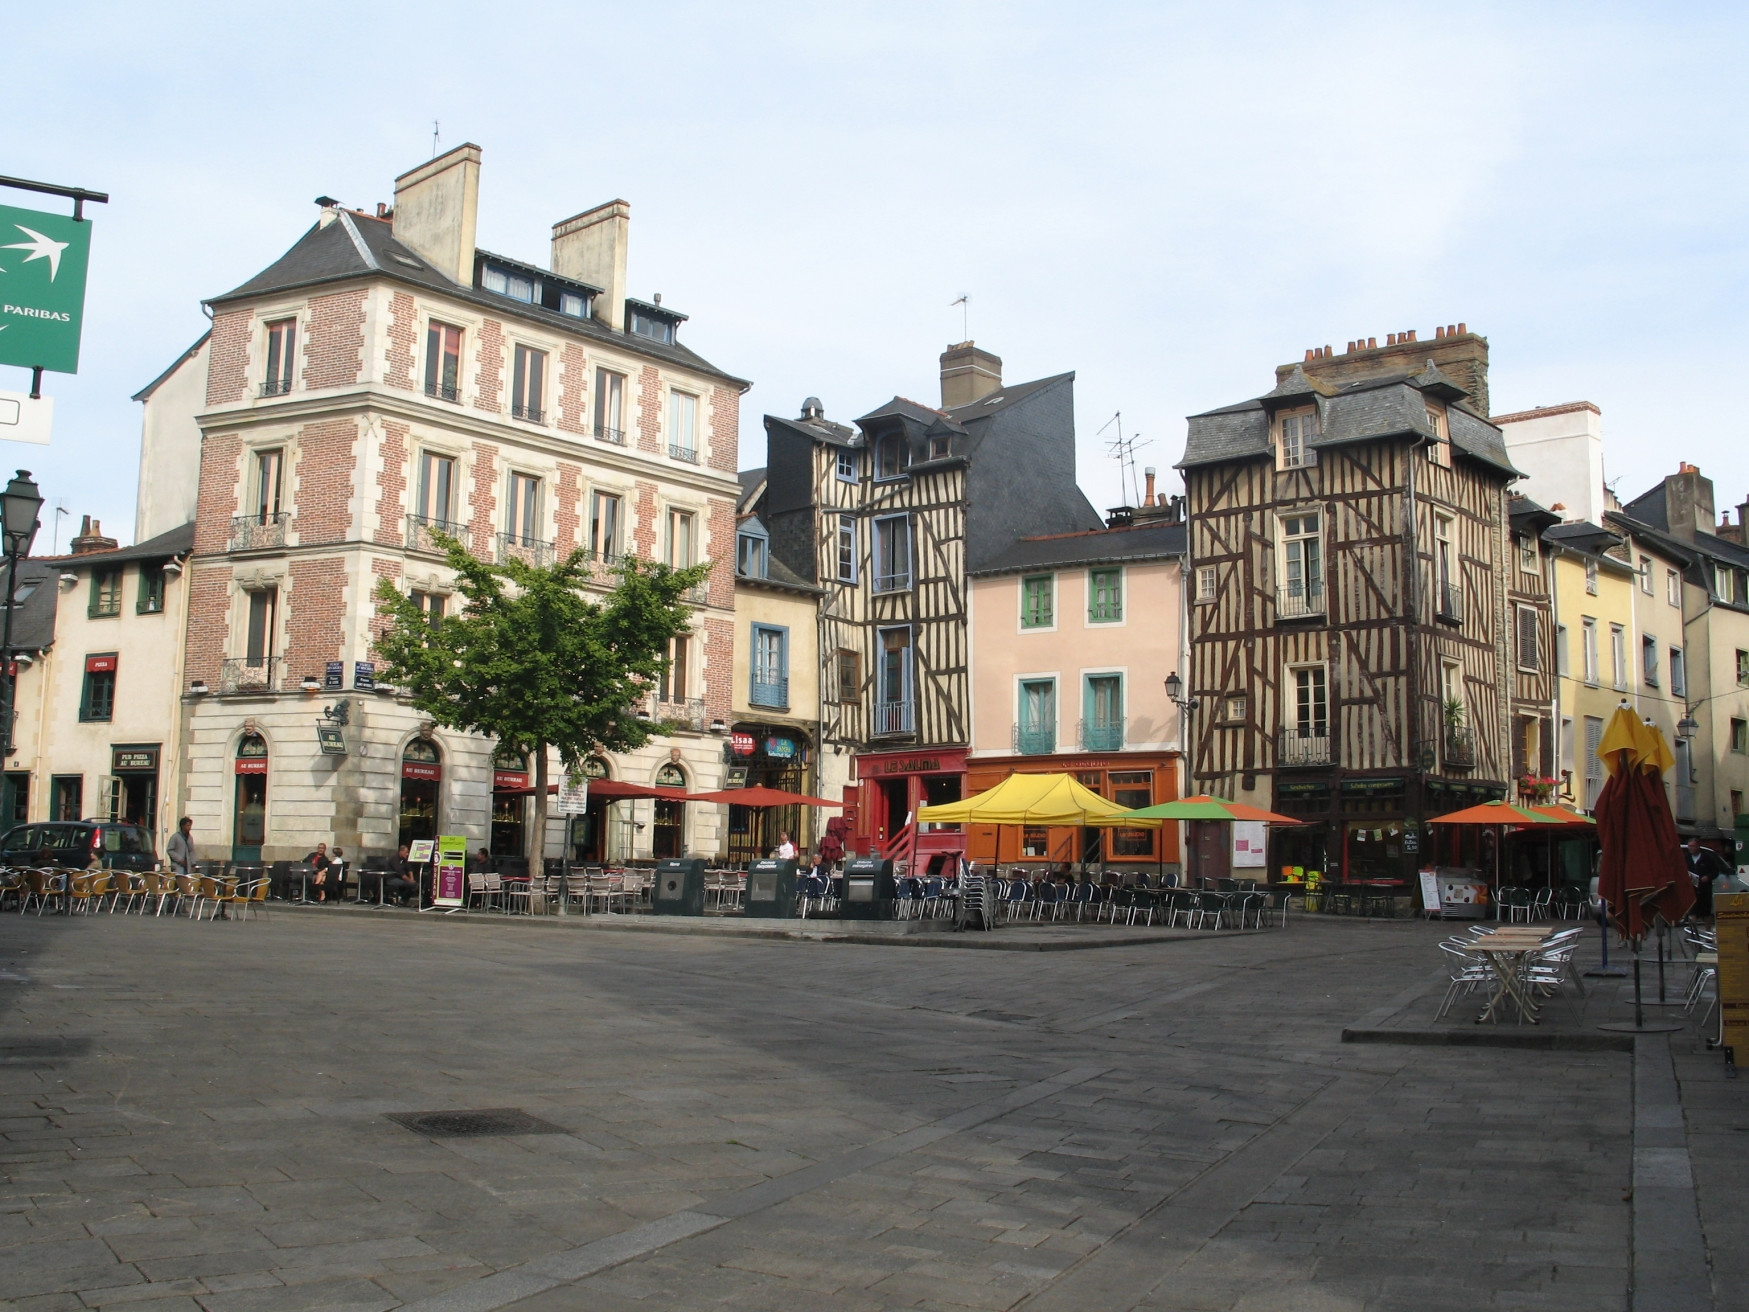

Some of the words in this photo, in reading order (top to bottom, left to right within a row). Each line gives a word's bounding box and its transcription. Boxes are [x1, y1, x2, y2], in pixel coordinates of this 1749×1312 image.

[4, 304, 70, 322] PARIBAS
[884, 761, 898, 773] LE
[900, 759, 940, 772] SALMA
